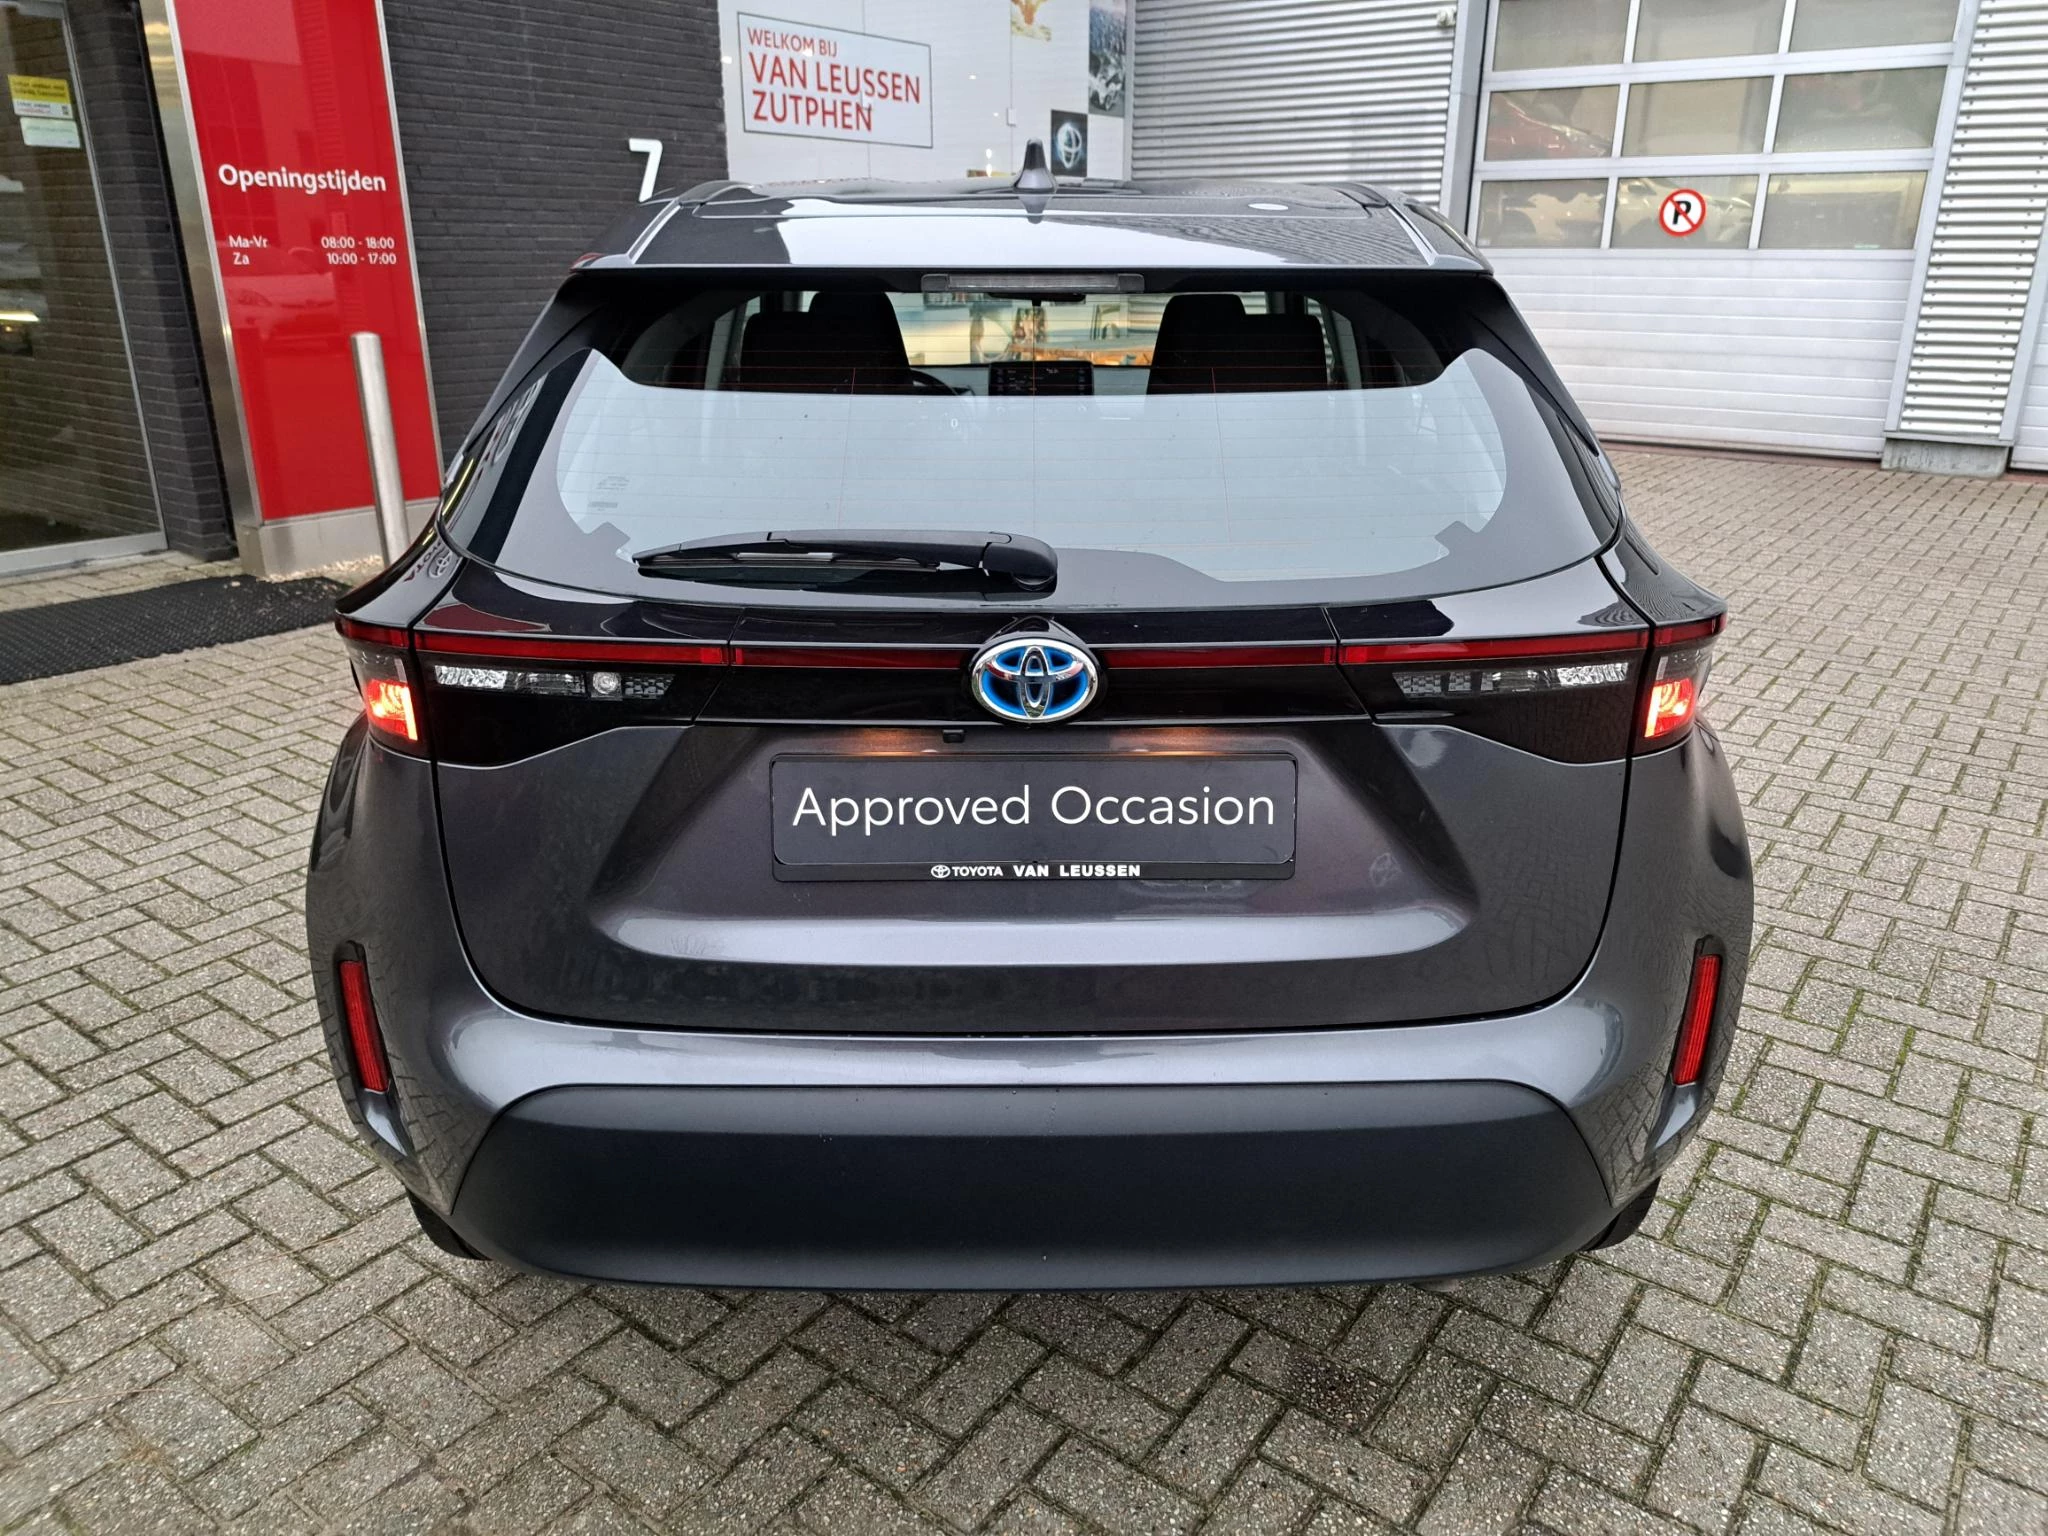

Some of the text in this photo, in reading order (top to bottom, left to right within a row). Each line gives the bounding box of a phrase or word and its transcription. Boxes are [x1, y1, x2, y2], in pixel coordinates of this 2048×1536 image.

[747, 27, 837, 58] WELKOM BIJ
[748, 51, 921, 105] VAN LEUSSEN
[752, 90, 873, 132] ZUTPHEN
[218, 163, 387, 196] Openingstijden
[629, 138, 663, 202] 7
[228, 235, 268, 249] Ma-Vr
[321, 237, 355, 249] 08:00
[365, 237, 395, 249] 18:00
[233, 252, 250, 265] Za
[326, 253, 357, 265] 10:00
[367, 253, 397, 265] 17:00
[792, 784, 1274, 837] Approved Occasion
[951, 865, 1141, 877] TOYOTA VAN LEUSSEN
